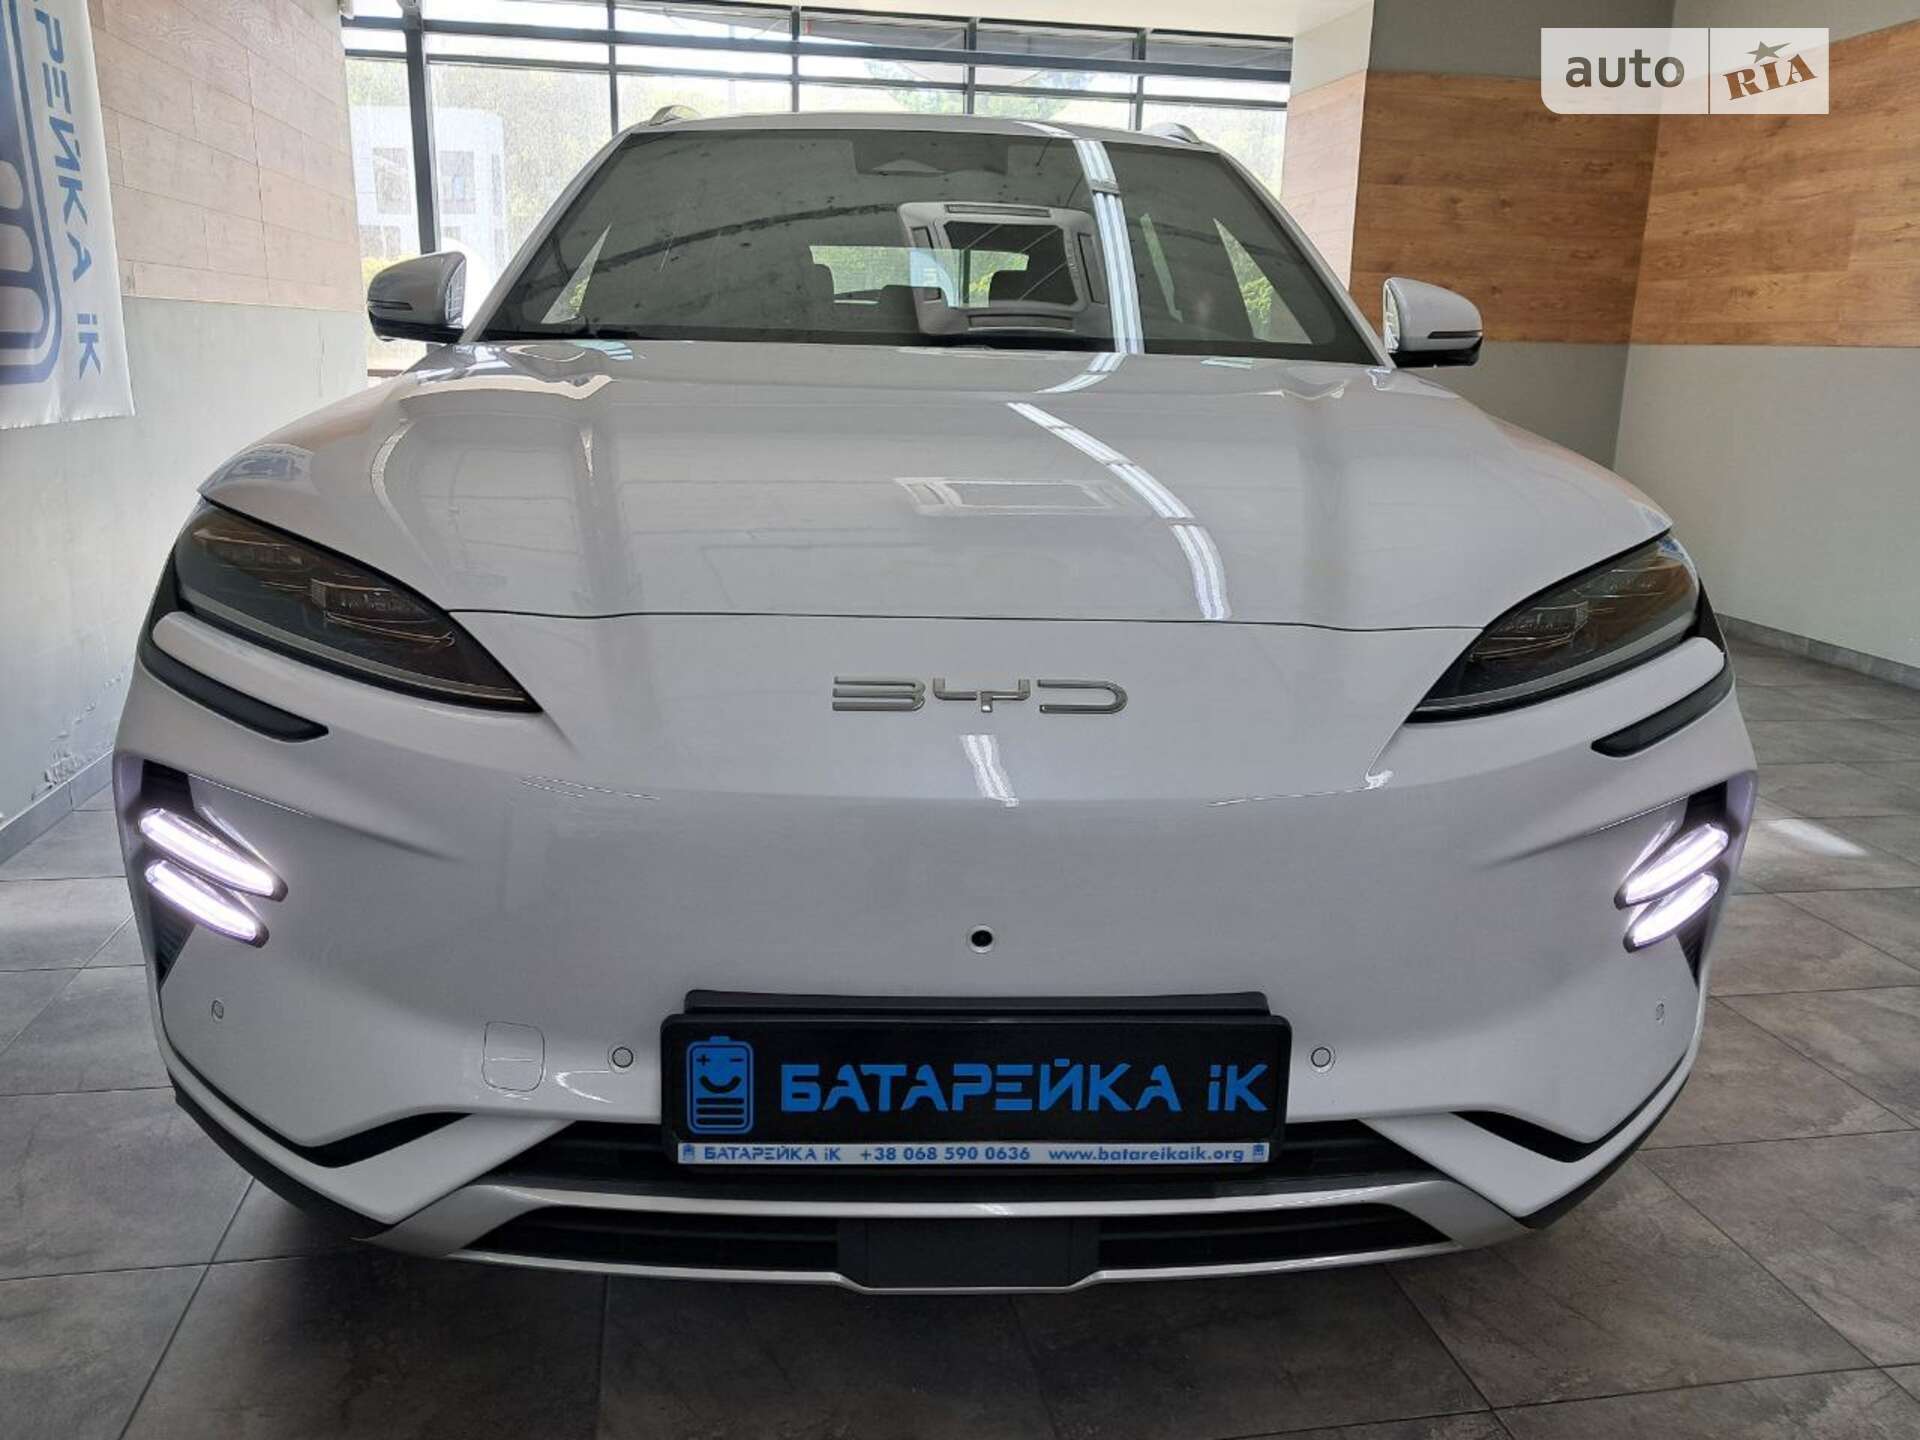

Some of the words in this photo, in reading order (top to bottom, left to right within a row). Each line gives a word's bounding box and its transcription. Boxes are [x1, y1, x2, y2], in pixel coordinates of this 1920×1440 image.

[33, 0, 92, 283] РЕЙКА
[831, 675, 1129, 715] BYD
[780, 1057, 1183, 1113] БАТАРЕЙКА
[704, 1145, 818, 1161] БАТАРЕЙКА
[860, 1146, 897, 1161] +38
[903, 1146, 938, 1161] 068
[943, 1146, 979, 1161] 590
[985, 1146, 1031, 1161] 0636
[1048, 1146, 1245, 1163] www.batareikaik.org
